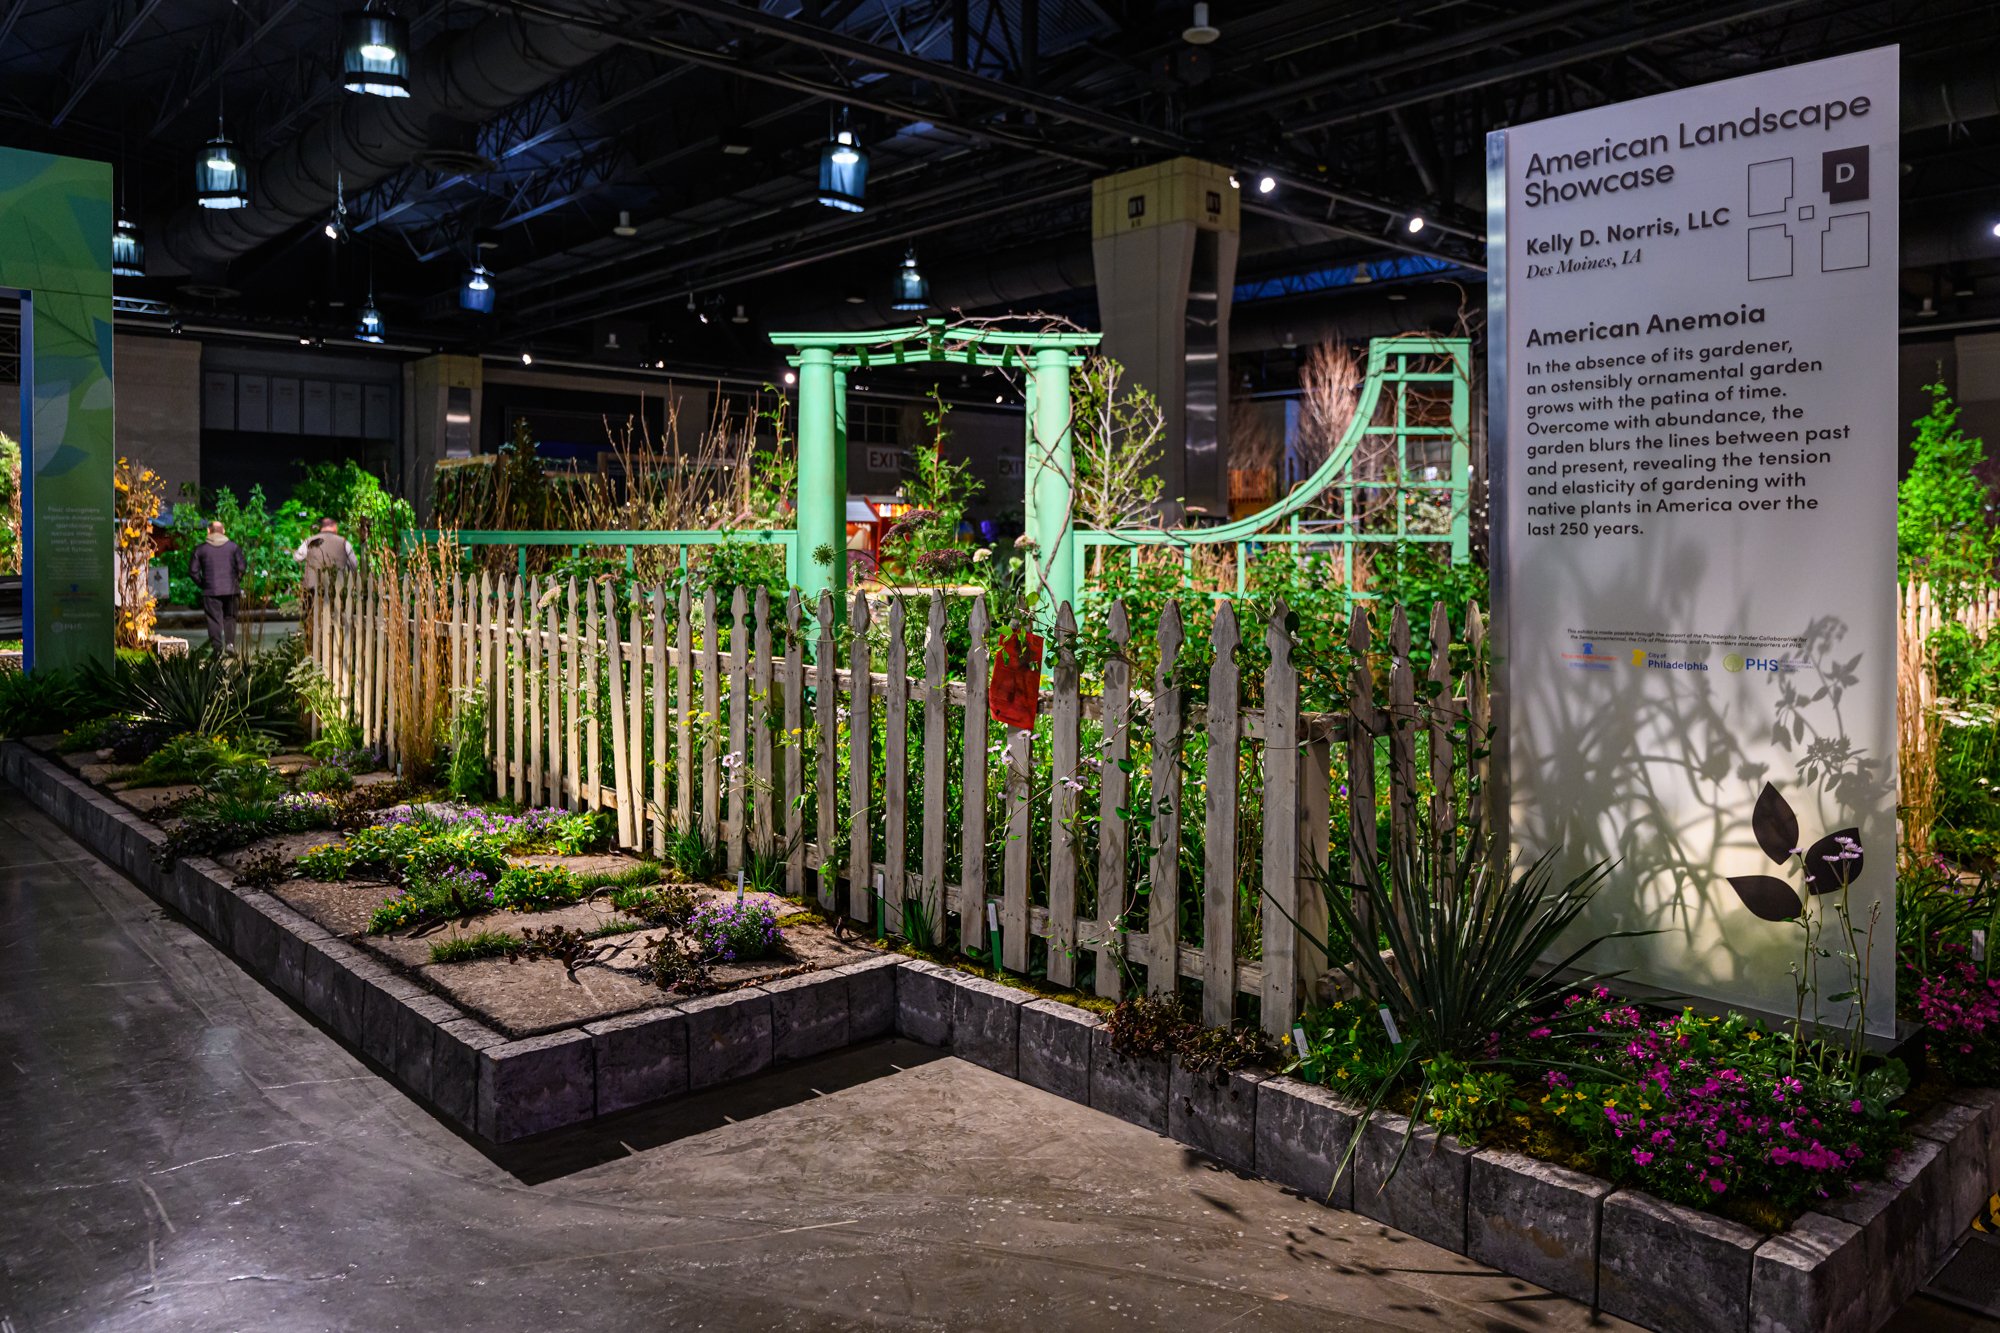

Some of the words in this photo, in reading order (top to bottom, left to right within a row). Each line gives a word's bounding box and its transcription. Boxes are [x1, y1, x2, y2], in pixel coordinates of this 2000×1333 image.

[1525, 134, 1668, 179] American
[1680, 96, 1871, 149] Landscape
[1525, 163, 1675, 208] Showcase
[1836, 163, 1855, 183] D
[1527, 234, 1574, 256] Kelly
[1580, 230, 1600, 248] D.
[1608, 218, 1679, 243] Norris,
[1688, 208, 1730, 230] LLC
[1527, 265, 1553, 279] Des
[1556, 256, 1616, 274] Moines,
[1622, 248, 1641, 265] IA
[1526, 322, 1639, 348] American
[1646, 304, 1765, 334] Anemoia
[1528, 363, 1540, 375] In
[1546, 360, 1571, 373] the
[1576, 354, 1646, 370] absence
[1651, 348, 1669, 363] of
[1674, 347, 1693, 361] its
[1699, 340, 1792, 363] gardener,
[1527, 385, 1546, 395] an
[1551, 373, 1632, 393] ostensibly
[1638, 362, 1743, 385] ornamental
[1750, 358, 1822, 380] garden
[1527, 403, 1574, 419] grows
[1579, 396, 1612, 411] with
[1618, 394, 1645, 408] the
[1651, 390, 1708, 410] patina
[1715, 386, 1734, 401] of
[1739, 385, 1786, 399] time.
[1527, 421, 1609, 435] Overcome
[1614, 414, 1649, 429] with
[1655, 409, 1765, 427] abundance,
[1772, 404, 1803, 419] the
[1527, 440, 1584, 459] garden
[1590, 438, 1630, 452] blurs
[1636, 435, 1663, 449] the
[1669, 434, 1709, 448] lines
[1716, 431, 1798, 445] between
[1806, 425, 1850, 445] past
[1527, 461, 1556, 475] and
[1562, 459, 1627, 478] present,
[1634, 454, 1716, 472] revealing
[1722, 452, 1752, 467] the
[1759, 449, 1830, 465] tension
[1528, 481, 1557, 496] and
[1562, 479, 1635, 496] elasticity
[1640, 477, 1657, 492] of
[1662, 475, 1758, 495] gardening
[1765, 472, 1805, 487] with
[1528, 502, 1575, 515] native
[1581, 501, 1631, 518] plants
[1637, 500, 1651, 513] in
[1656, 497, 1732, 512] America
[1738, 500, 1781, 511] over
[1786, 495, 1818, 510] the
[1528, 523, 1555, 535] last
[1560, 522, 1588, 535] 250
[1594, 525, 1643, 538] years.
[1648, 660, 1709, 671] Philadelphia
[1746, 658, 1778, 672] PHS
